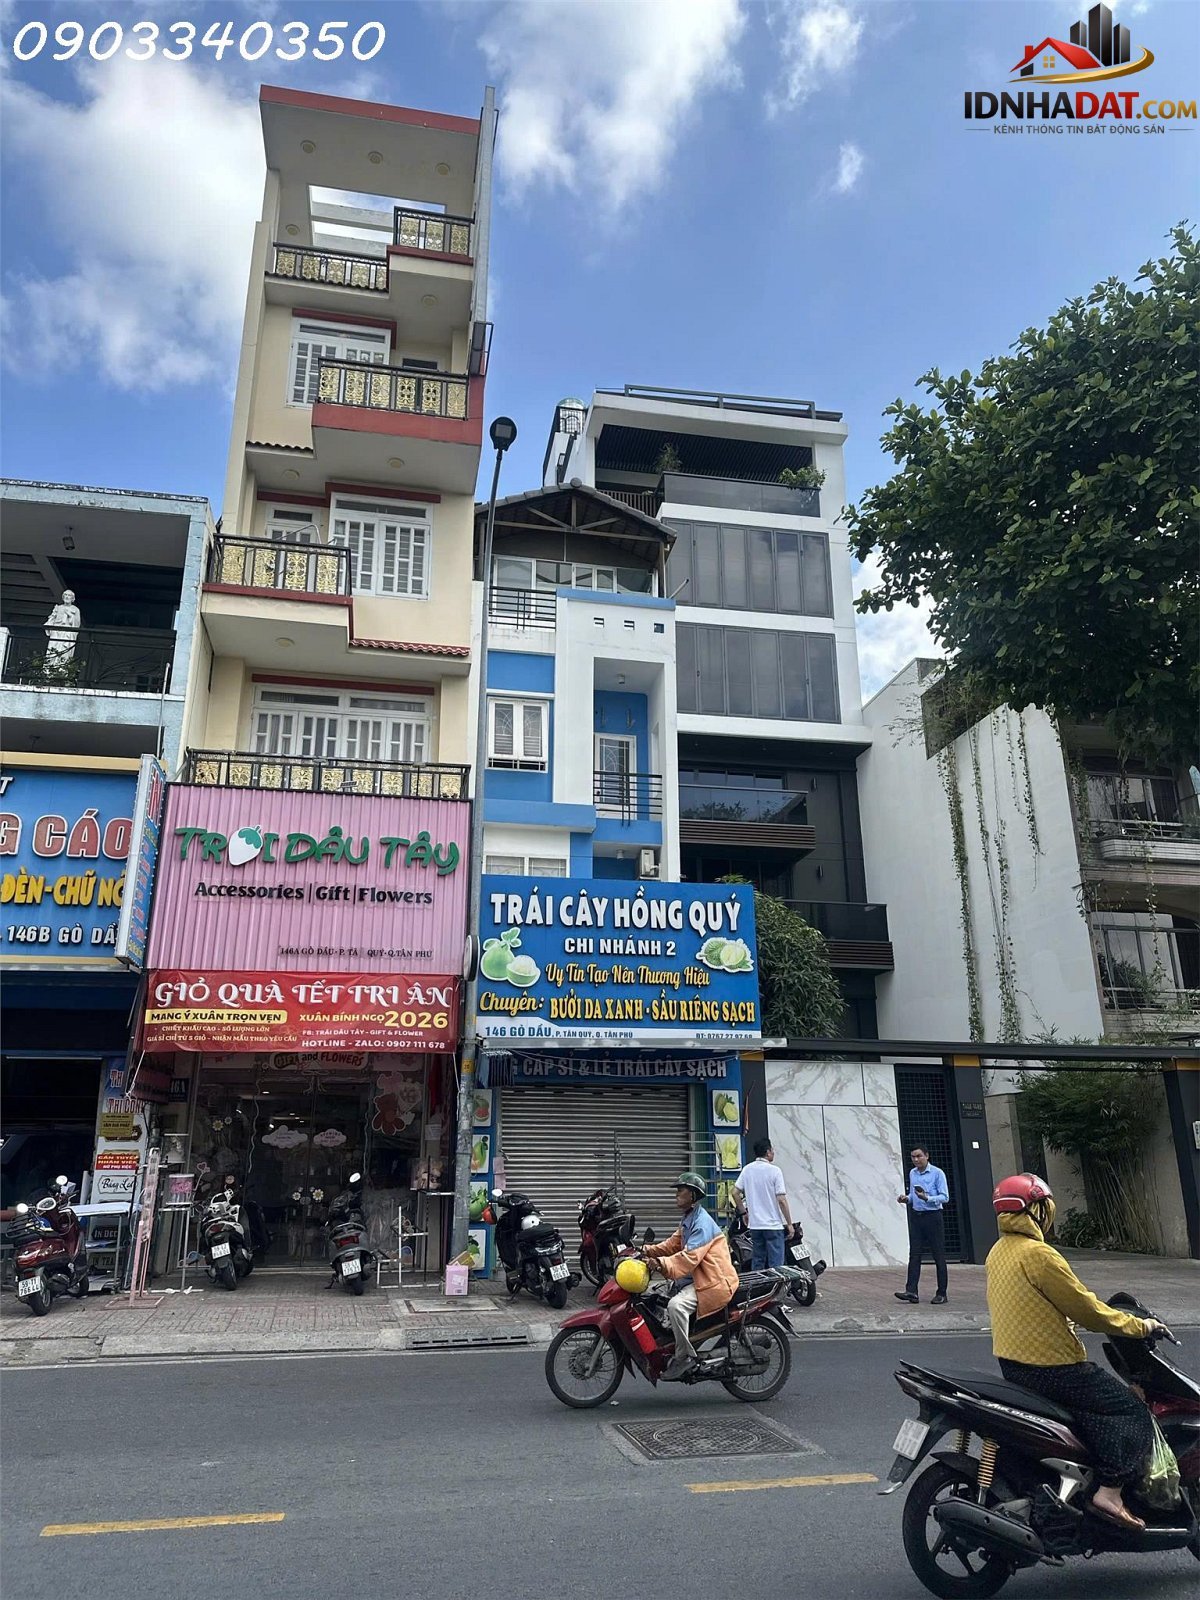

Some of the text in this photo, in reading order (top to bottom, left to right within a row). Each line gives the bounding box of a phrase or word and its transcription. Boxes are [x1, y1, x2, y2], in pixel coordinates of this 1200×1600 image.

[32, 808, 133, 860] CÁO
[284, 826, 370, 864] DÂU
[194, 882, 304, 900] Accessories
[315, 885, 350, 902] Gift
[358, 887, 433, 904] Flowers
[490, 885, 741, 937] TRÁI CÂY HỒNG QUÝ
[8, 922, 118, 945] 146B GÒ DẦ
[564, 935, 676, 956] CHI NHÁNH 2
[545, 963, 564, 987] Uy
[565, 963, 585, 982] Tín
[586, 963, 609, 987] Tạo
[611, 965, 635, 984] Nên
[155, 976, 453, 1008] GIỎ QUÀ TẾT TRI ÂN
[151, 1009, 281, 1023] MANG Ý XUÂN TRỌN VẸN
[479, 990, 544, 1016] Chuyên:
[550, 988, 581, 1019] BƯỞI
[584, 998, 602, 1019] DA
[605, 999, 643, 1020] XANH
[652, 988, 677, 1020] SẦU
[680, 994, 719, 1021] RIÊNG
[722, 1001, 755, 1027] SẠCH
[300, 1012, 330, 1022] XUÂN
[361, 1013, 385, 1024] NGỌ
[384, 1010, 448, 1029] 2026
[485, 1026, 506, 1037] 146
[302, 1039, 346, 1047] HOTLINE
[354, 1039, 384, 1047] ZALO:
[386, 1040, 411, 1048] 0907
[428, 1041, 446, 1049] 678
